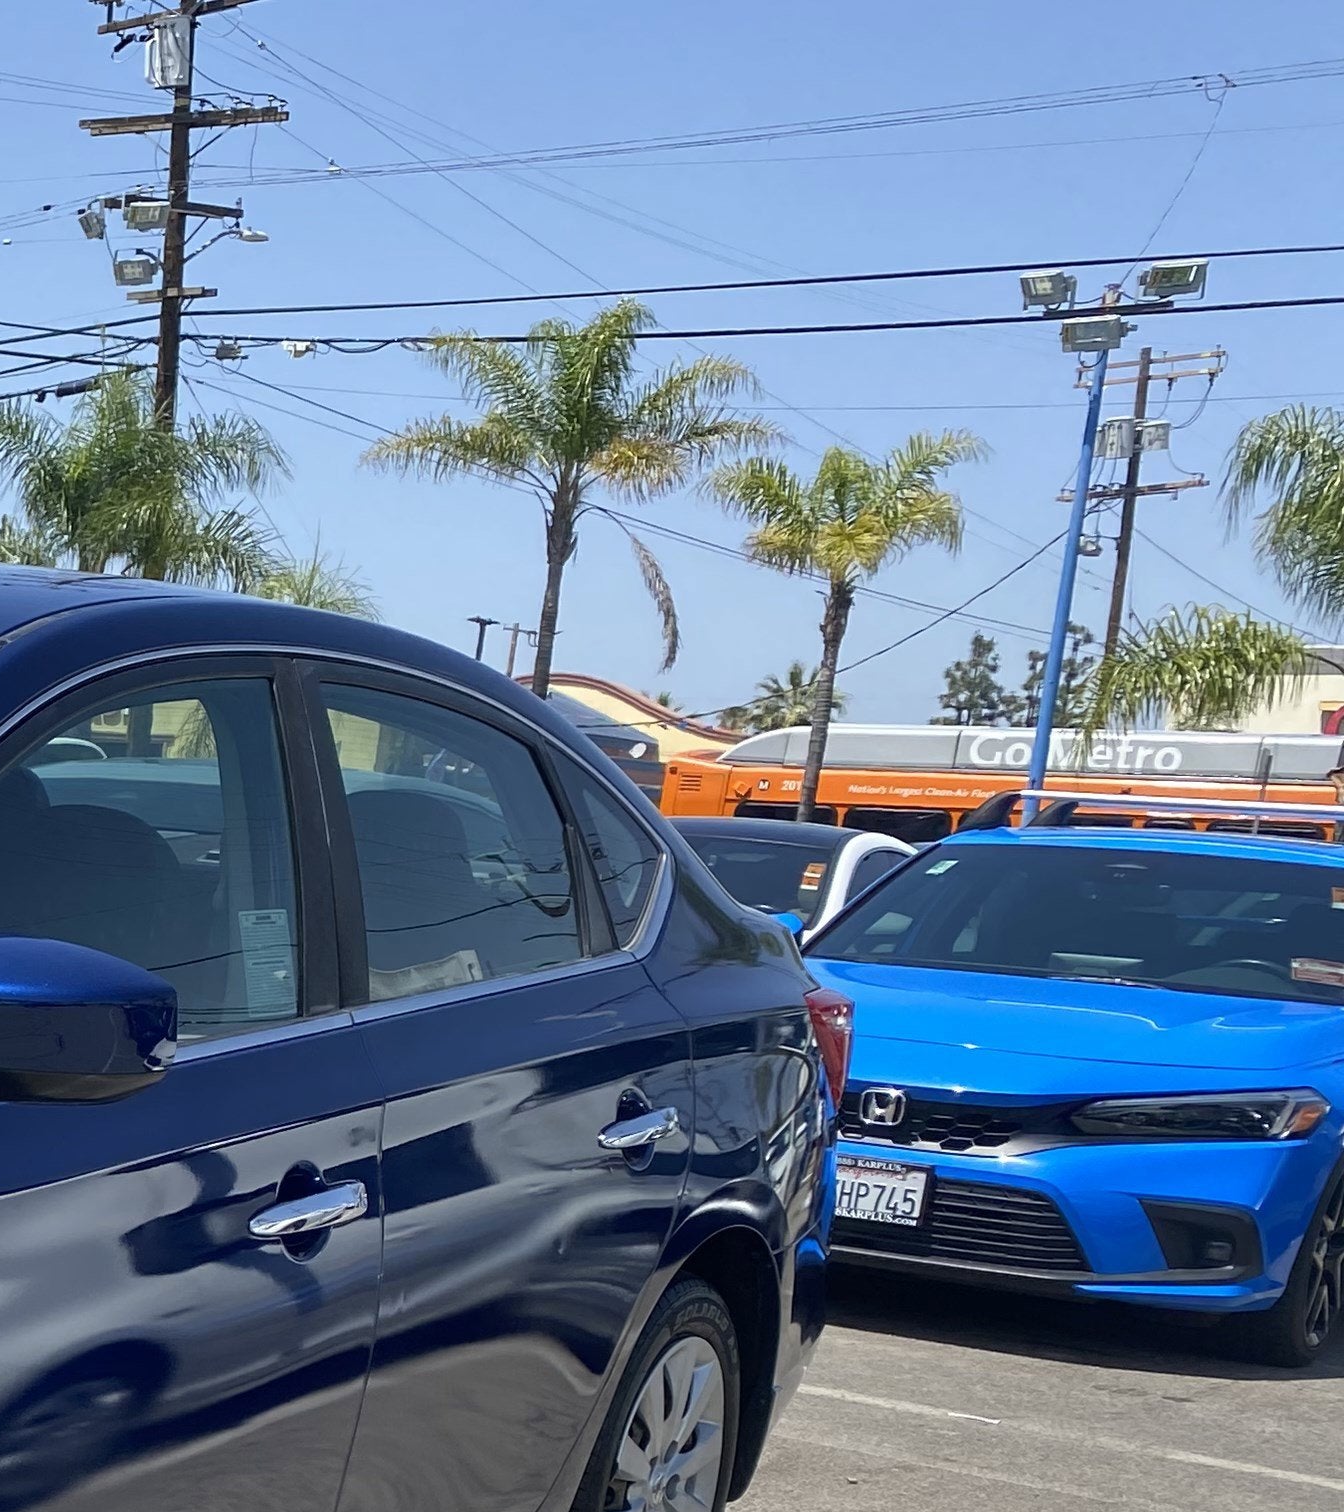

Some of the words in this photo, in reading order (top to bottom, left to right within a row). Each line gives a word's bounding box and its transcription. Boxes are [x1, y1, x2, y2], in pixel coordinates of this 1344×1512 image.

[970, 734, 1032, 768] Go
[1047, 734, 1182, 772] Metro
[889, 786, 923, 797] Largest
[857, 1159, 902, 1172] KARPLUS
[837, 1180, 917, 1216] HP745
